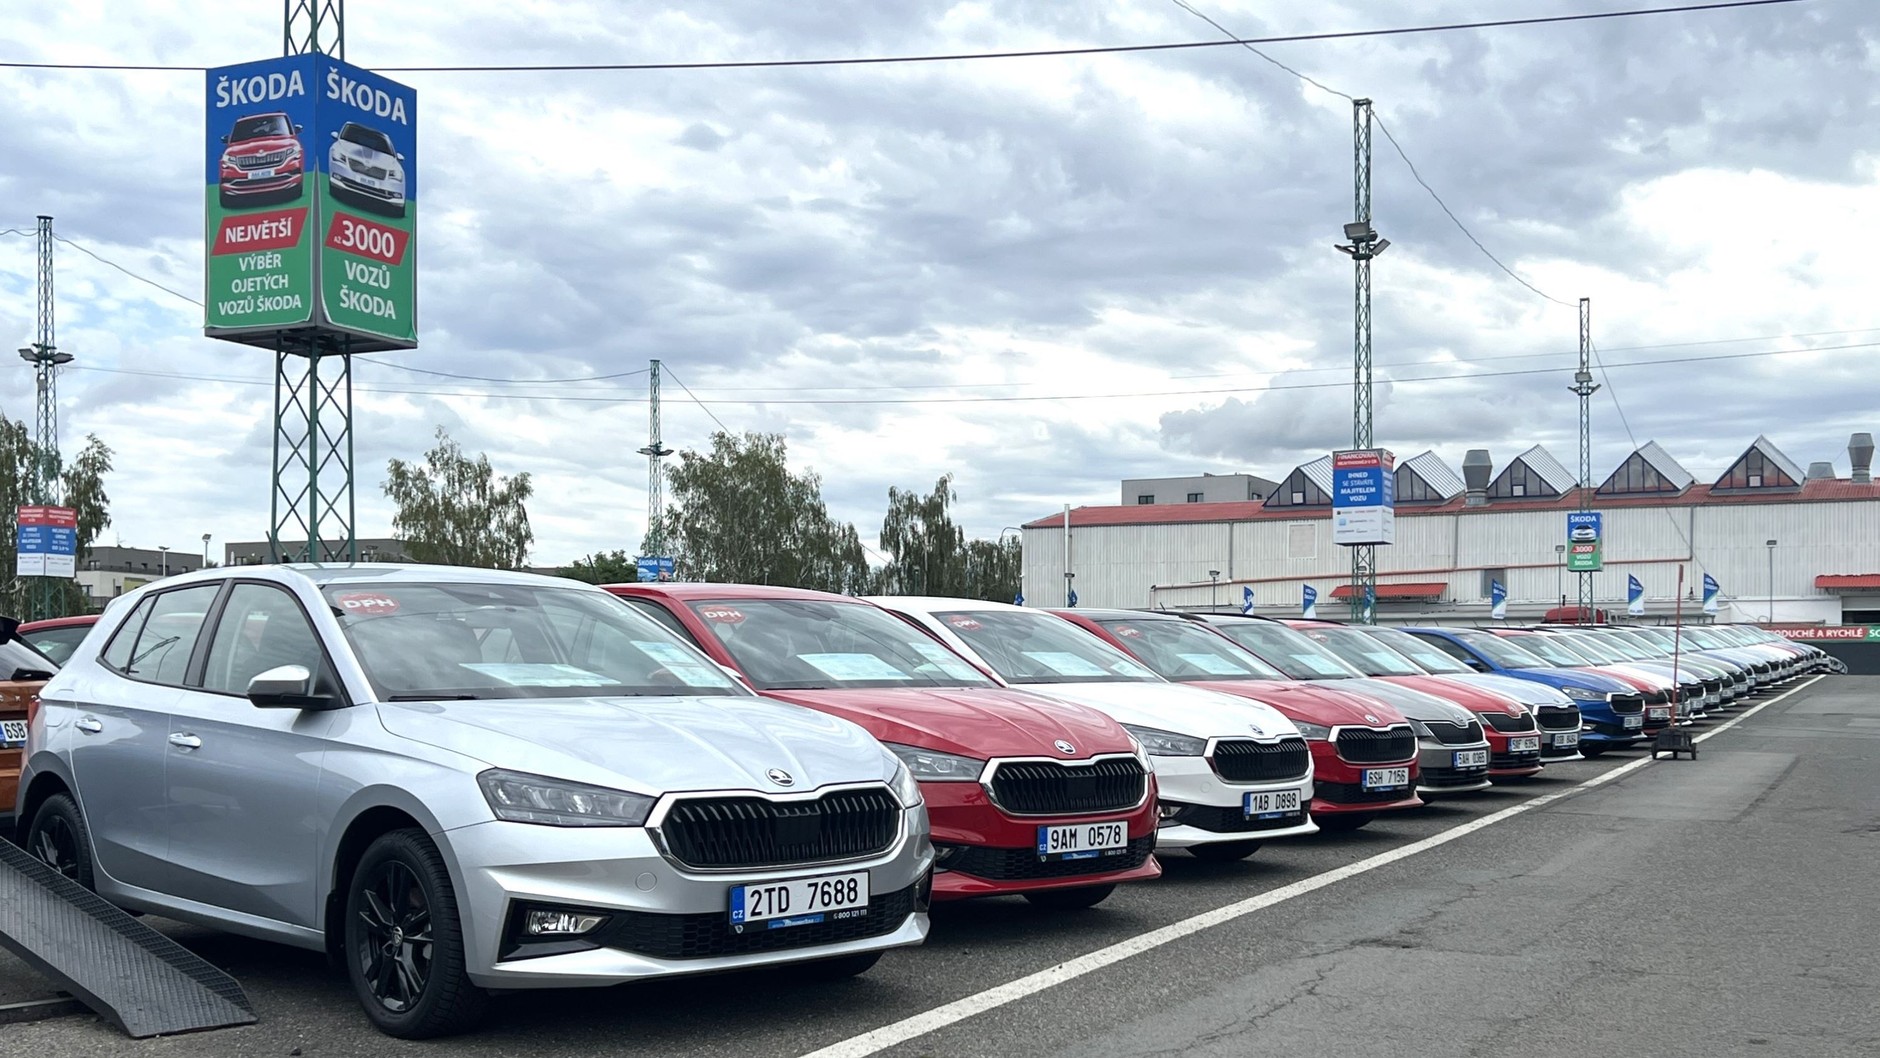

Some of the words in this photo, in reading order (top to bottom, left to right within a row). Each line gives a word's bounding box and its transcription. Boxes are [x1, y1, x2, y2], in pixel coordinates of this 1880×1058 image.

[216, 70, 304, 108] ŠKODA
[327, 66, 407, 125] ŠKODA
[225, 217, 292, 244] NEJVĚTŠÍ
[342, 220, 395, 258] 3000
[239, 253, 282, 271] VÝBĚR
[344, 259, 391, 289] VOZŮ
[231, 274, 289, 294] OJETÝCH
[218, 296, 254, 316] VOZŮ
[256, 294, 302, 312] ŠKODA
[339, 284, 396, 320] ŠKODA
[1348, 471, 1368, 479] IHNED
[1570, 515, 1597, 523] ŠKODA
[1575, 545, 1593, 553] 3000
[343, 597, 395, 609] DPH
[704, 609, 742, 620] DPH
[1770, 628, 1815, 638] ODUCHÉ
[1816, 629, 1824, 637] A
[1826, 628, 1863, 638] RYCHLÉ
[4, 722, 26, 739] 6SB
[1368, 771, 1383, 785] 6SH
[1388, 769, 1406, 783] 7156
[1253, 795, 1269, 811] 1AB
[1051, 828, 1077, 849] 9AM
[1088, 824, 1121, 846] 0578
[750, 886, 790, 917] 2TD
[807, 877, 858, 910] 7688
[732, 909, 744, 919] CZ
[838, 911, 850, 919] 800
